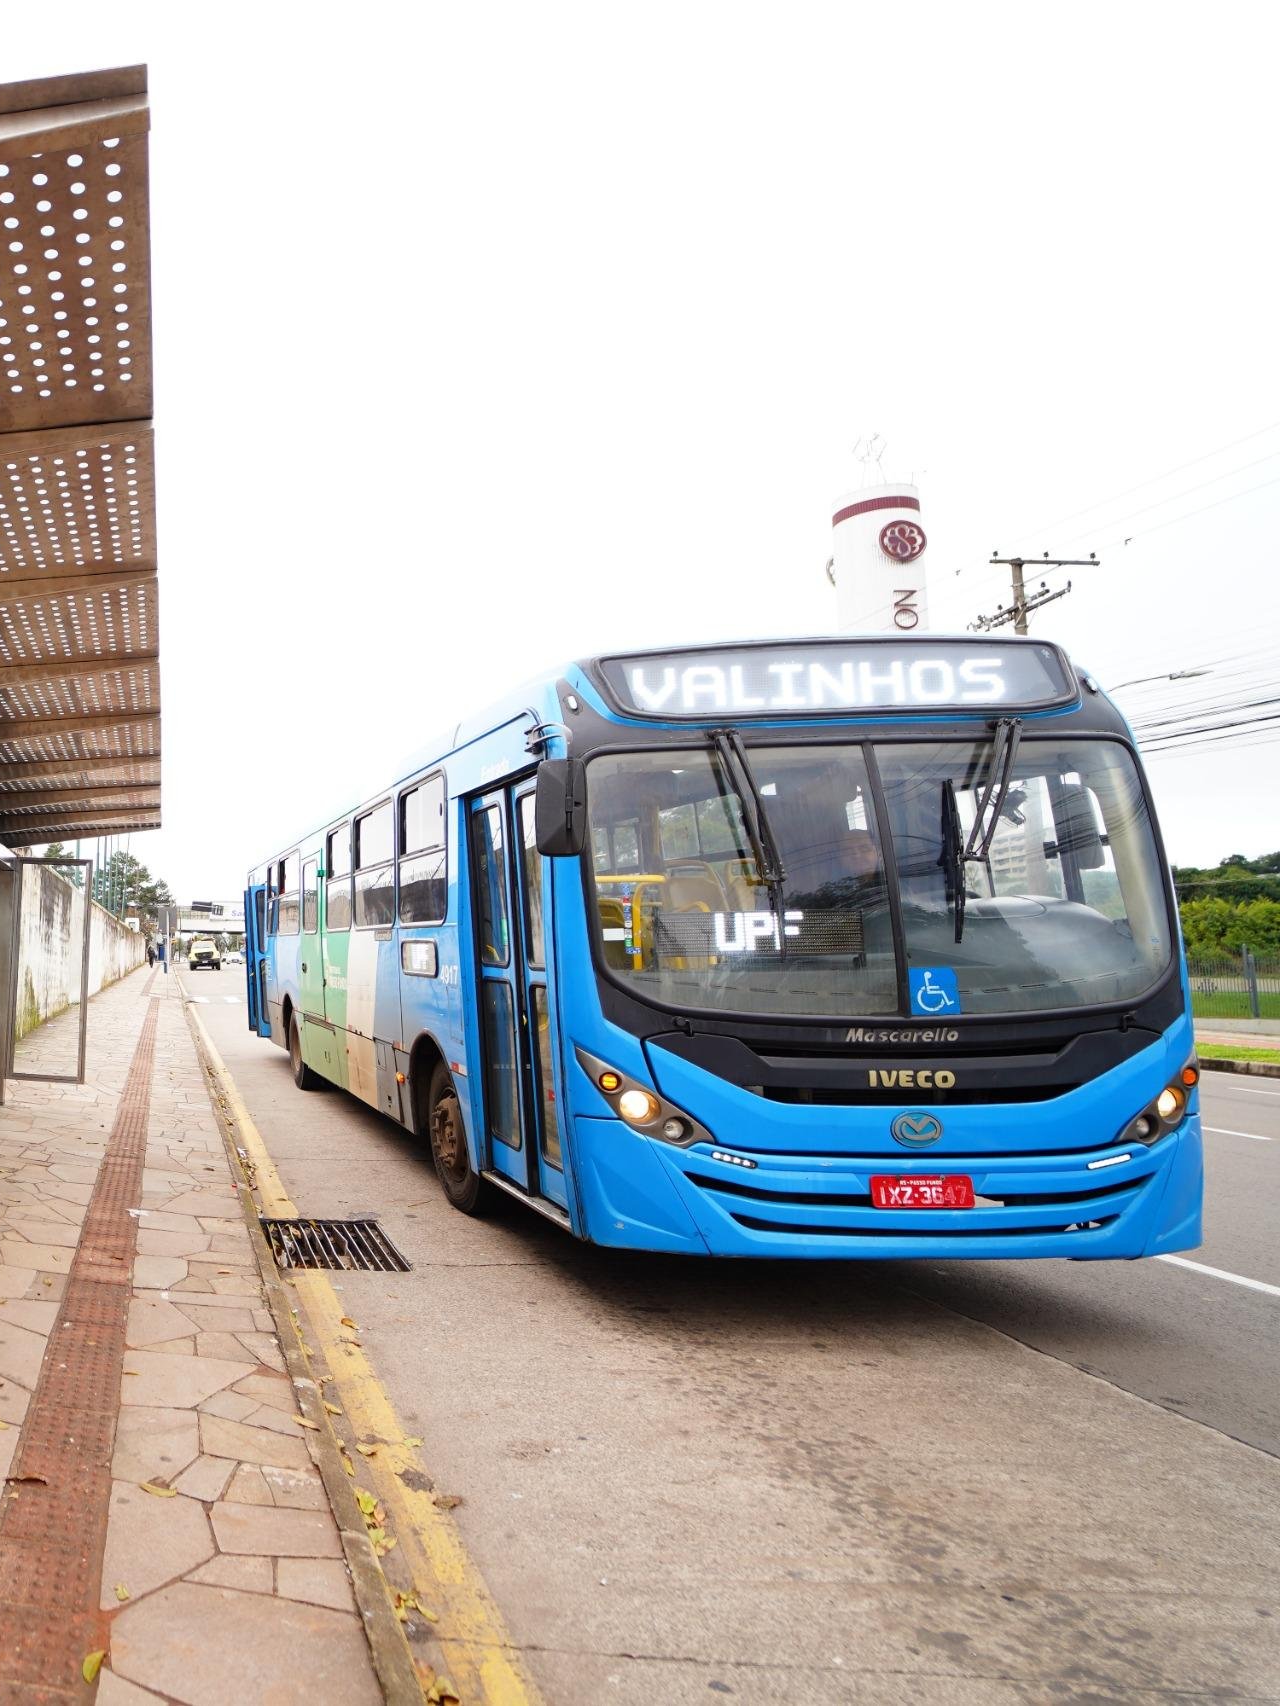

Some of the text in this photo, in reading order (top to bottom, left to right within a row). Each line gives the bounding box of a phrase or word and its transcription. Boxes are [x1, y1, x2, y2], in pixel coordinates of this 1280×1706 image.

[631, 658, 1006, 708] VALINHOS
[440, 965, 458, 985] 4917
[846, 1028, 959, 1042] Mascarello
[868, 1070, 956, 1088] IVECO
